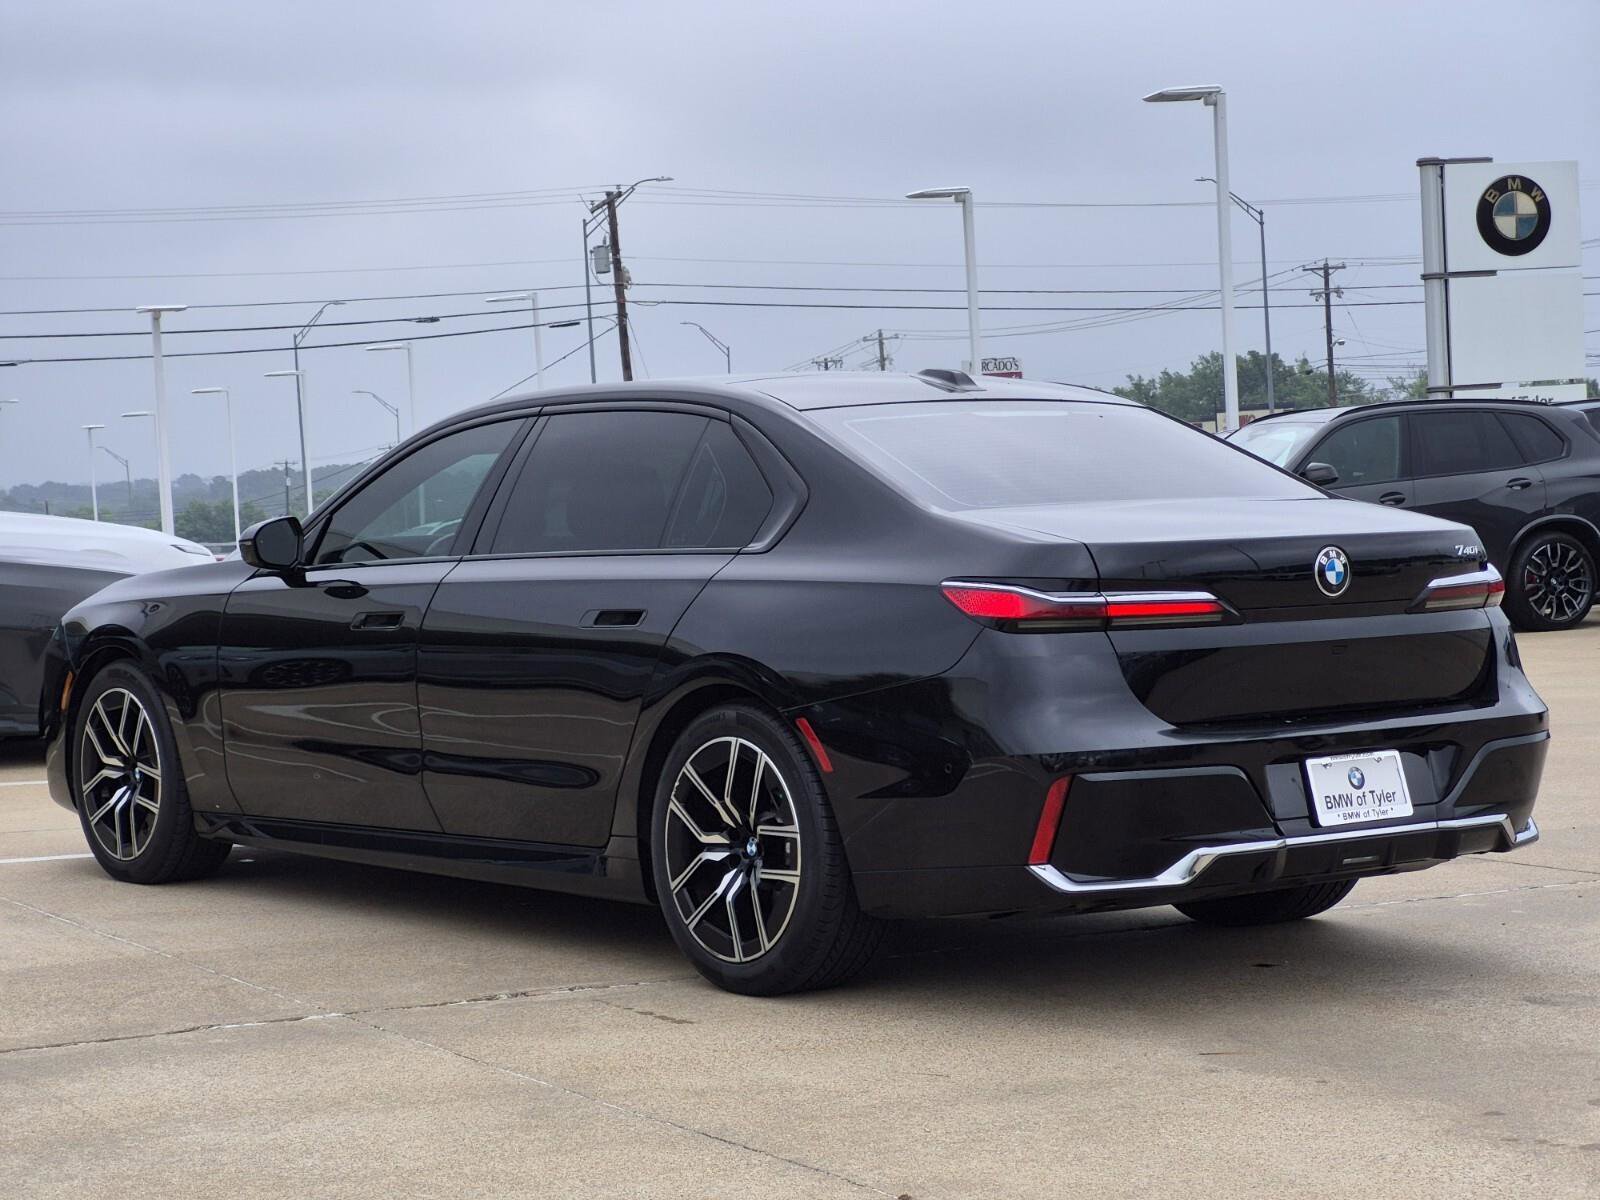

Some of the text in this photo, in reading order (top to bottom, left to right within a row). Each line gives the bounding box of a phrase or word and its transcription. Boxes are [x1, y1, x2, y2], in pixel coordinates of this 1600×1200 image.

[1484, 178, 1544, 204] BMW
[978, 361, 1019, 372] RCADO'S
[1455, 545, 1478, 556] 740i
[1320, 550, 1346, 565] BMW
[1324, 789, 1397, 810] BMW of Tyler
[1343, 808, 1389, 820] BMW of Tyler
